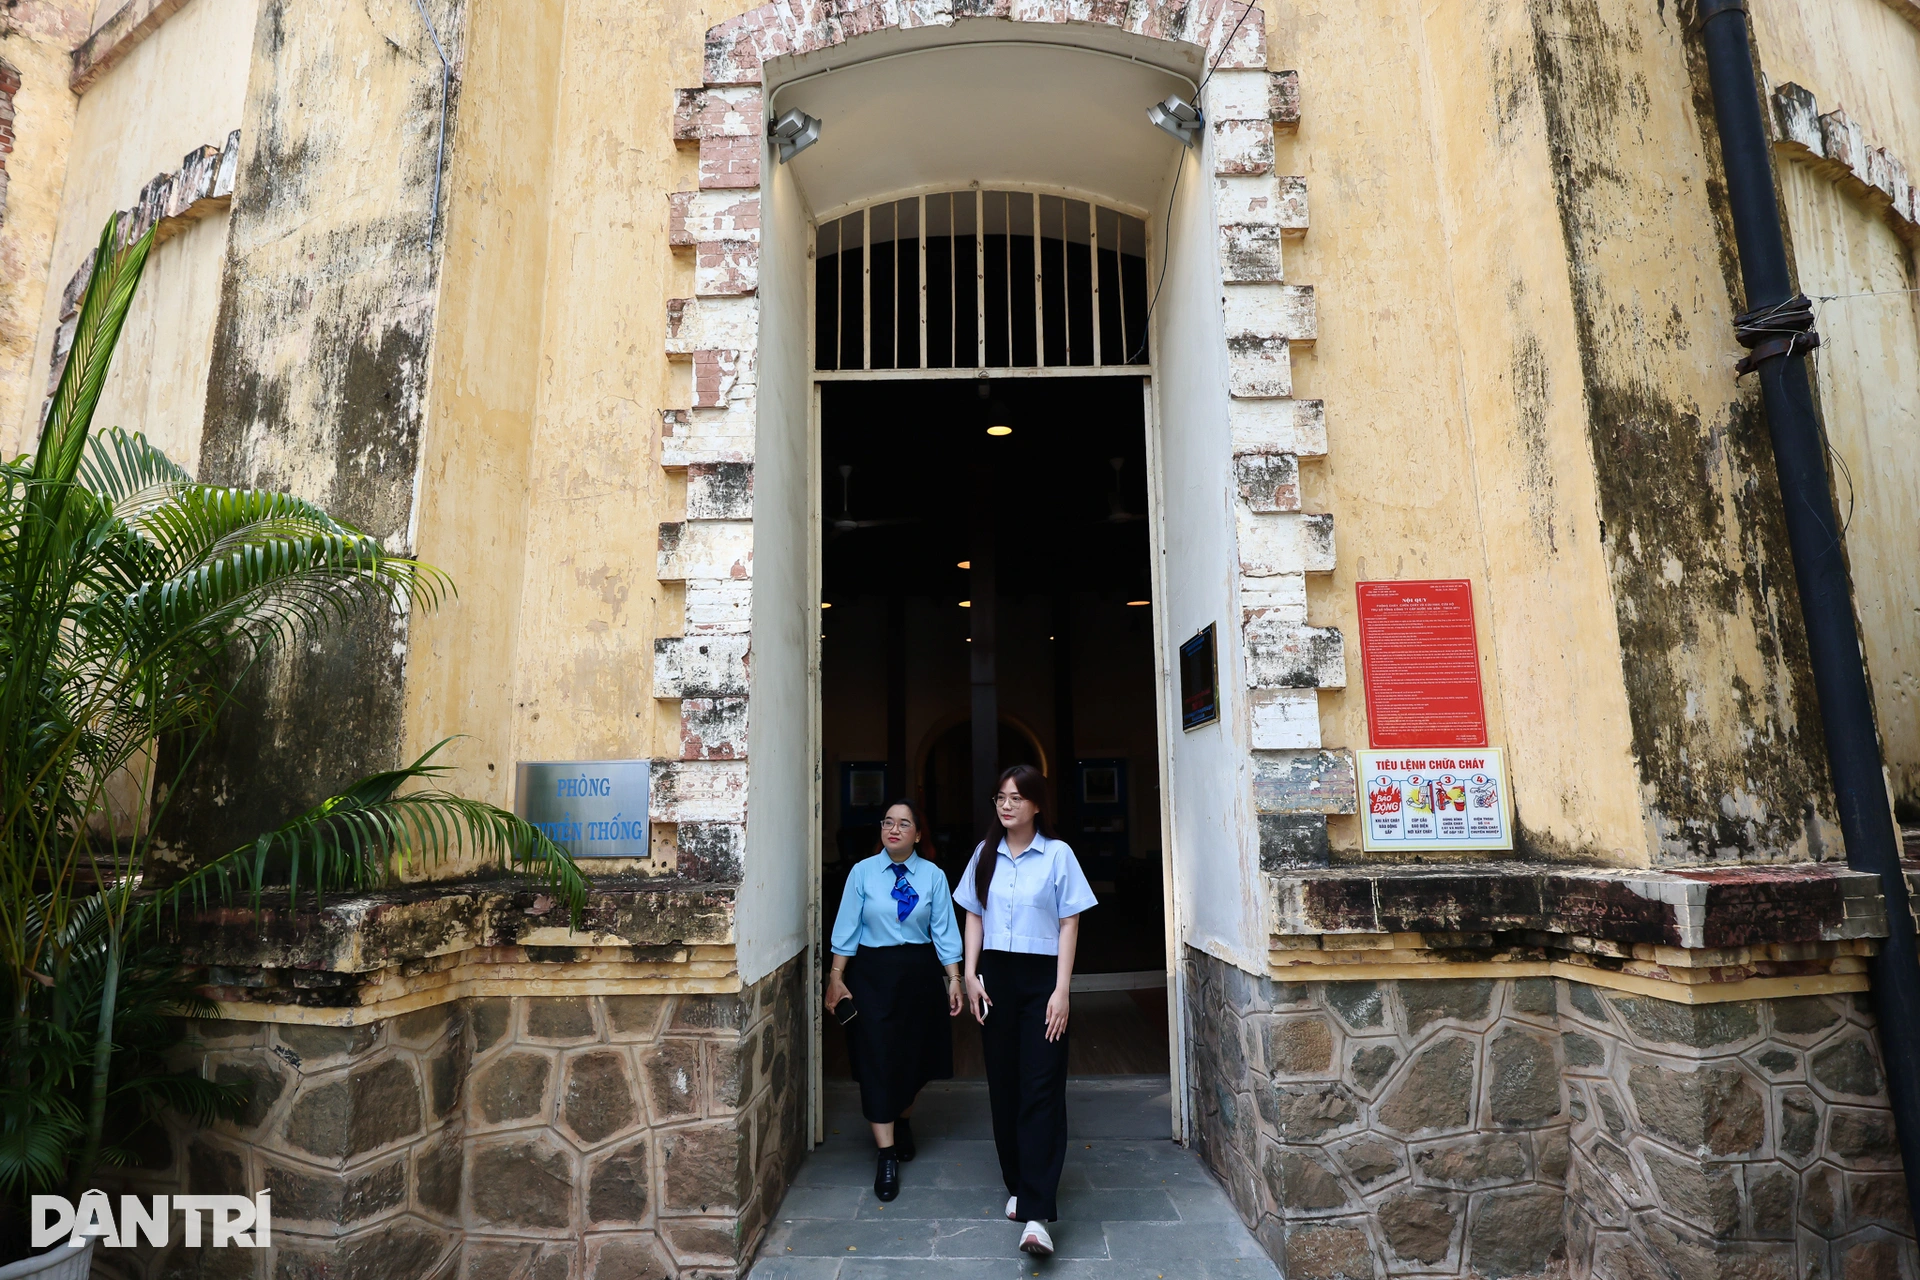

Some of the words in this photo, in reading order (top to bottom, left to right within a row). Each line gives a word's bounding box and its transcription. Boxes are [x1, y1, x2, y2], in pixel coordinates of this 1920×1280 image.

[1376, 759, 1397, 770] TIÊU
[1401, 758, 1426, 771] LỆNH
[1429, 757, 1455, 769] CHỮA
[1459, 757, 1484, 769] CHÁY
[556, 773, 611, 797] PHÒNG
[1412, 776, 1419, 784] 2
[1373, 801, 1399, 813] ĐỘNG
[530, 812, 582, 840] UYỀN
[587, 812, 643, 841] THỐNG
